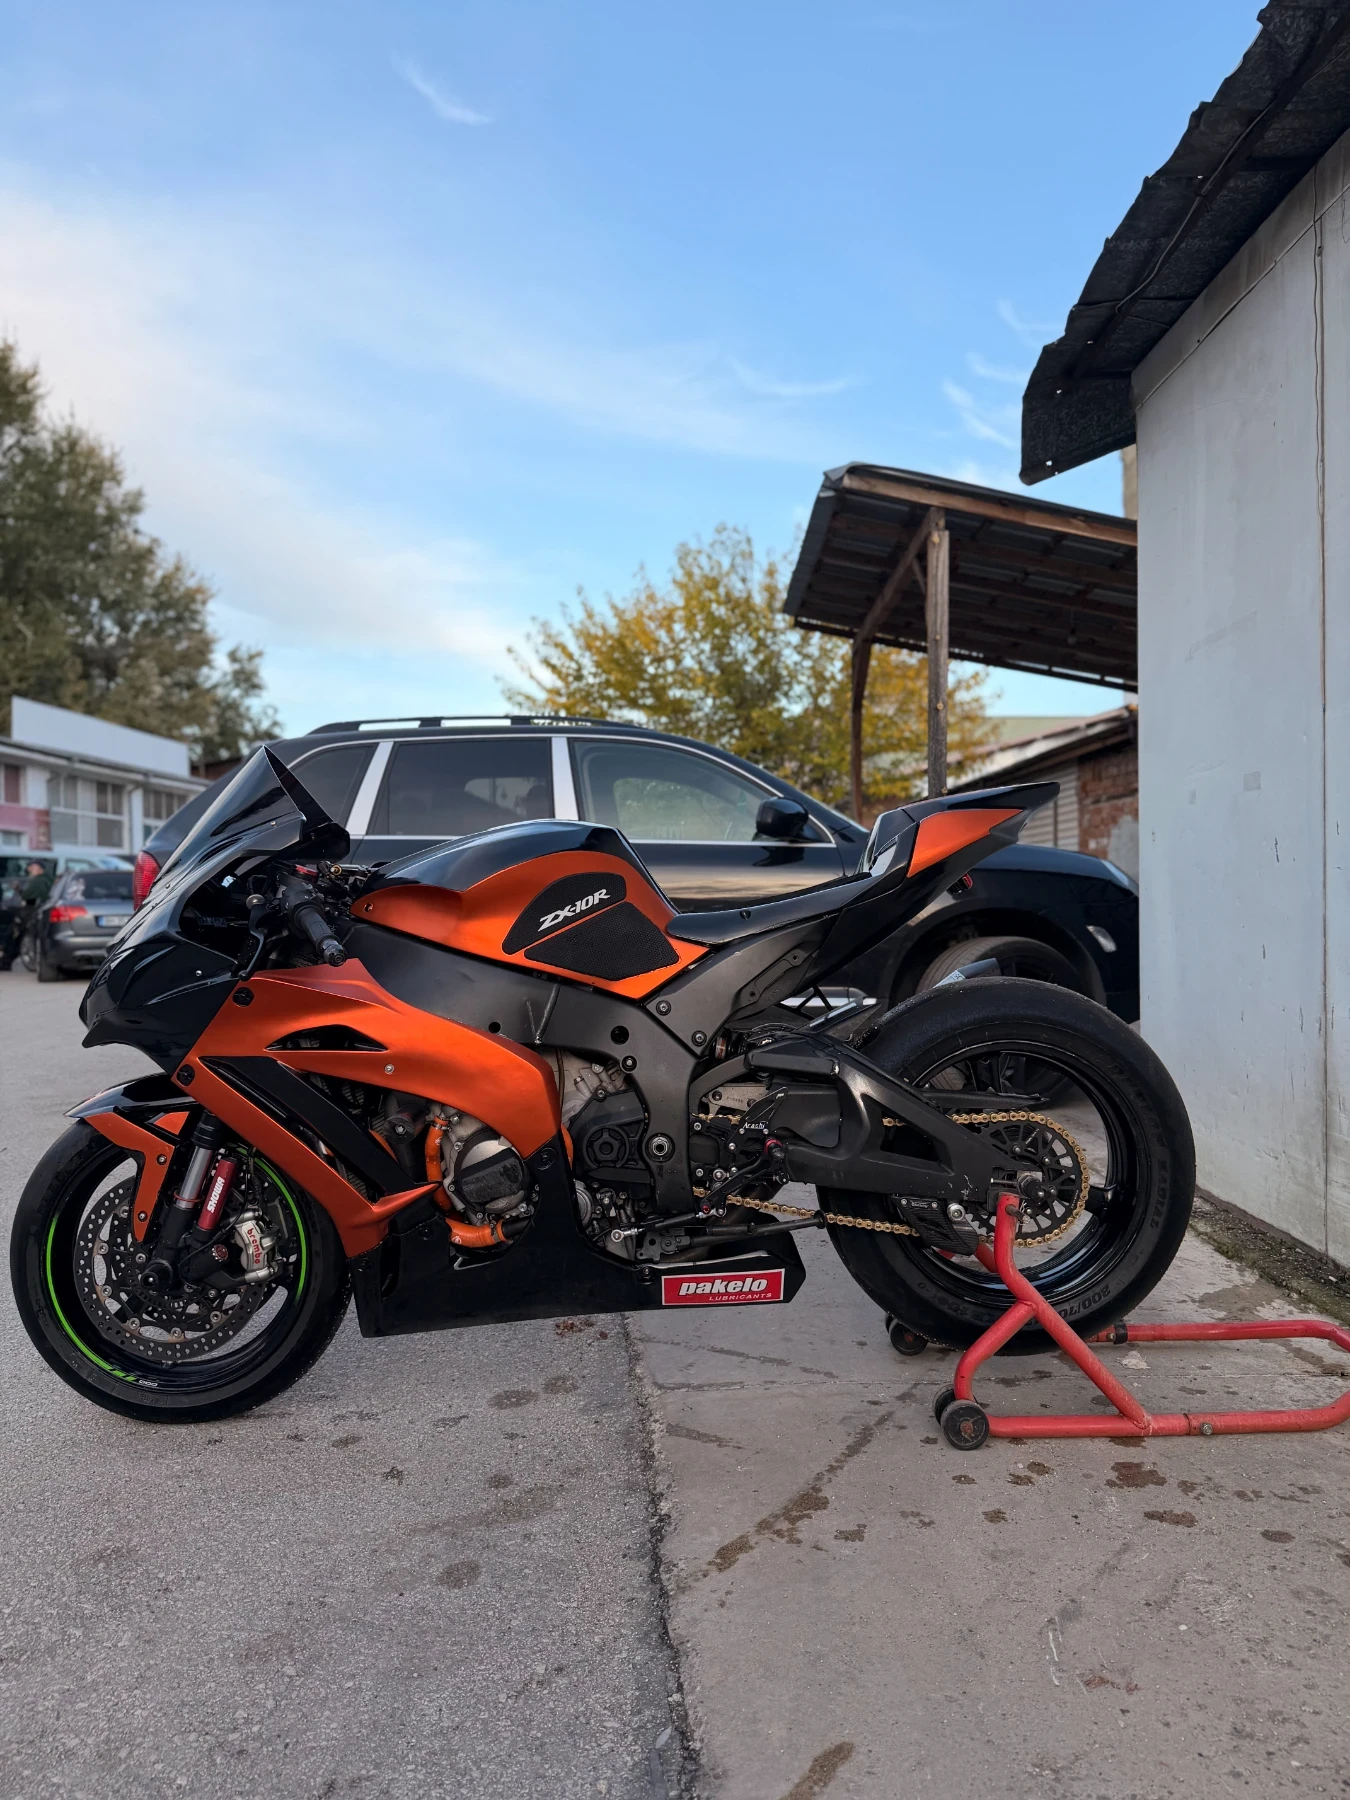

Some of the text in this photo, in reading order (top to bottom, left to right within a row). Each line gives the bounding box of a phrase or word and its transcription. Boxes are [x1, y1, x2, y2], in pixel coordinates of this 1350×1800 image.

[538, 888, 611, 932] ZX-10R
[207, 1176, 225, 1213] SHOWA
[247, 1228, 263, 1265] brembo
[678, 1277, 768, 1296] pakelo
[709, 1293, 772, 1301] LUBRICANTS
